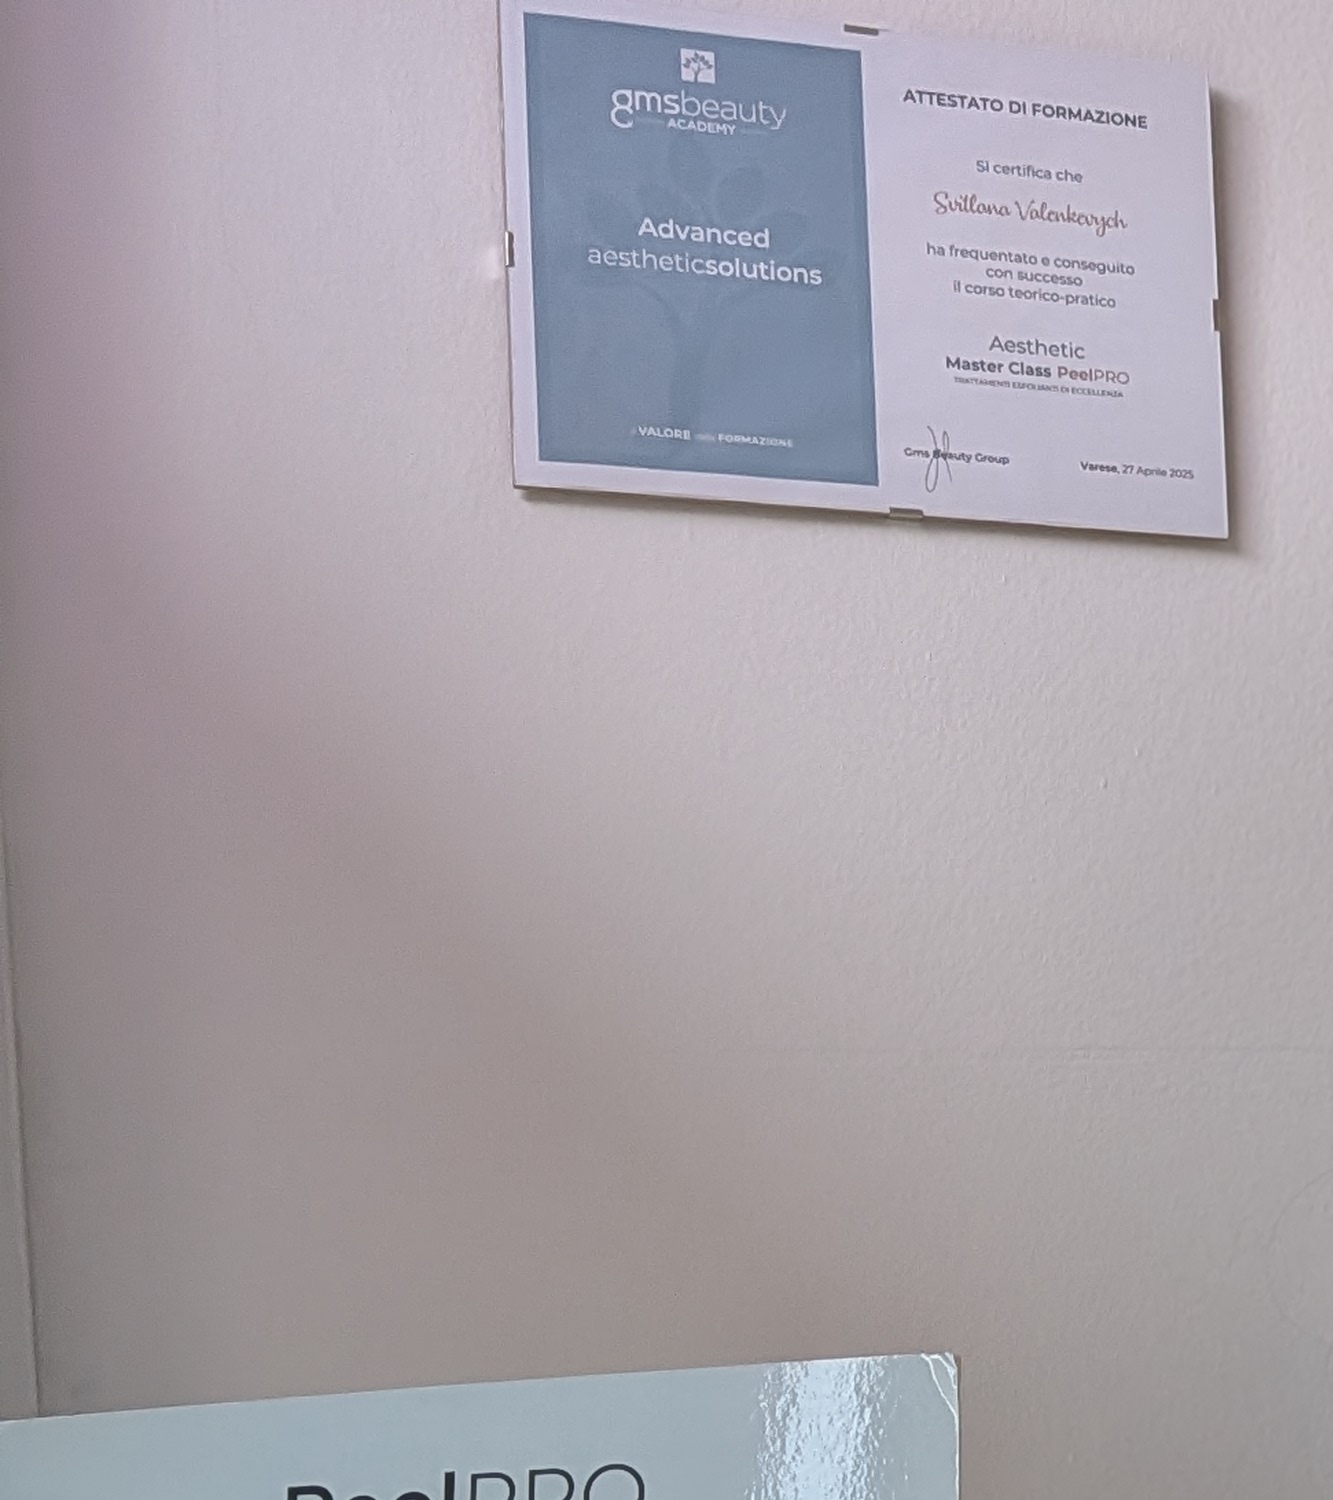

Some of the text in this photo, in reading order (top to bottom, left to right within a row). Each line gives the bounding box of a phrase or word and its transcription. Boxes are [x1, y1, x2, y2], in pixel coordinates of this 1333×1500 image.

[611, 89, 787, 130] gmsbeauty
[903, 89, 1148, 129] ATTESTATO DI FORMAZIONE
[667, 118, 736, 135] ACADEMY
[976, 160, 1083, 184] Si certifica che
[638, 217, 770, 249] Advanced
[587, 248, 823, 285] aestheticsolutions
[926, 242, 1135, 276] ha frequentato e conseguito
[986, 268, 1083, 287] con successo
[953, 280, 1116, 309] il corso teorico-pratico
[989, 335, 1085, 360] Aesthetic
[945, 356, 1130, 385] Master Class PeelPRO
[904, 447, 930, 458] Gms
[975, 452, 1010, 466] Group
[1122, 464, 1135, 475] 27
[1169, 468, 1194, 480] 2025
